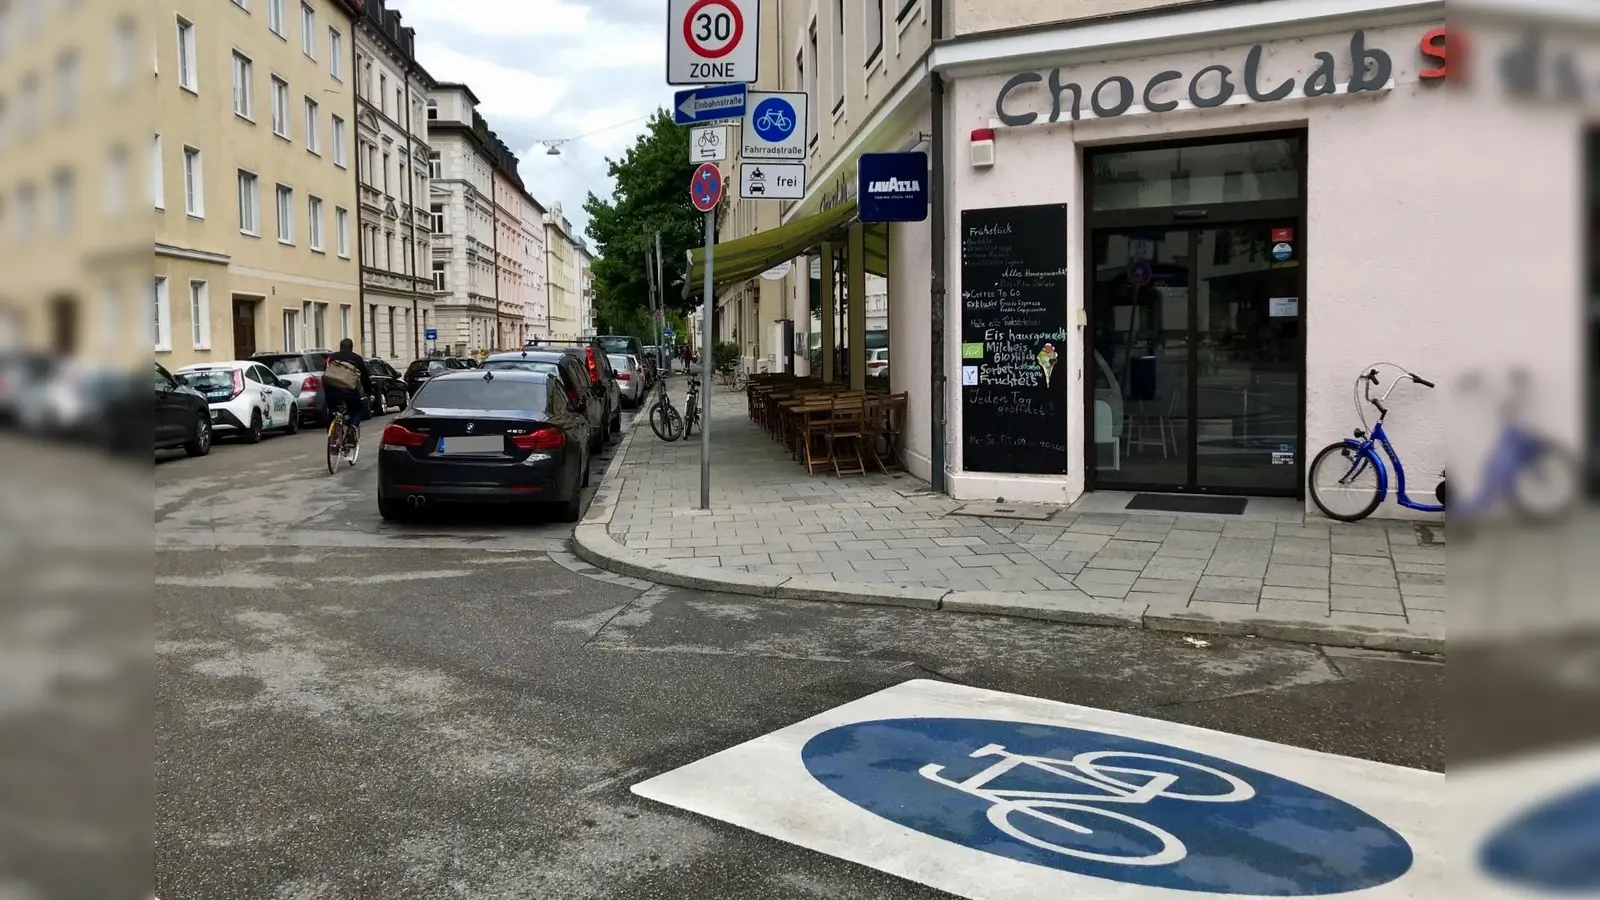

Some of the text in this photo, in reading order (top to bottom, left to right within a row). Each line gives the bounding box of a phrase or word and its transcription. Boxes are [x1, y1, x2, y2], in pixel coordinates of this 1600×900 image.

[695, 12, 731, 42] 30
[690, 63, 735, 78] ZONE
[995, 29, 1393, 127] ChocoLab
[693, 96, 743, 110] Einbahnstraße
[744, 145, 803, 155] Fahrradstraße
[776, 176, 797, 187] frei
[868, 177, 920, 193] LAVAZZA
[984, 328, 1005, 341] Eis
[986, 340, 1028, 353] Milcheis
[979, 363, 1014, 375] Sorbet
[979, 373, 1039, 387] Fruchteis
[969, 388, 1008, 404] Jeden
